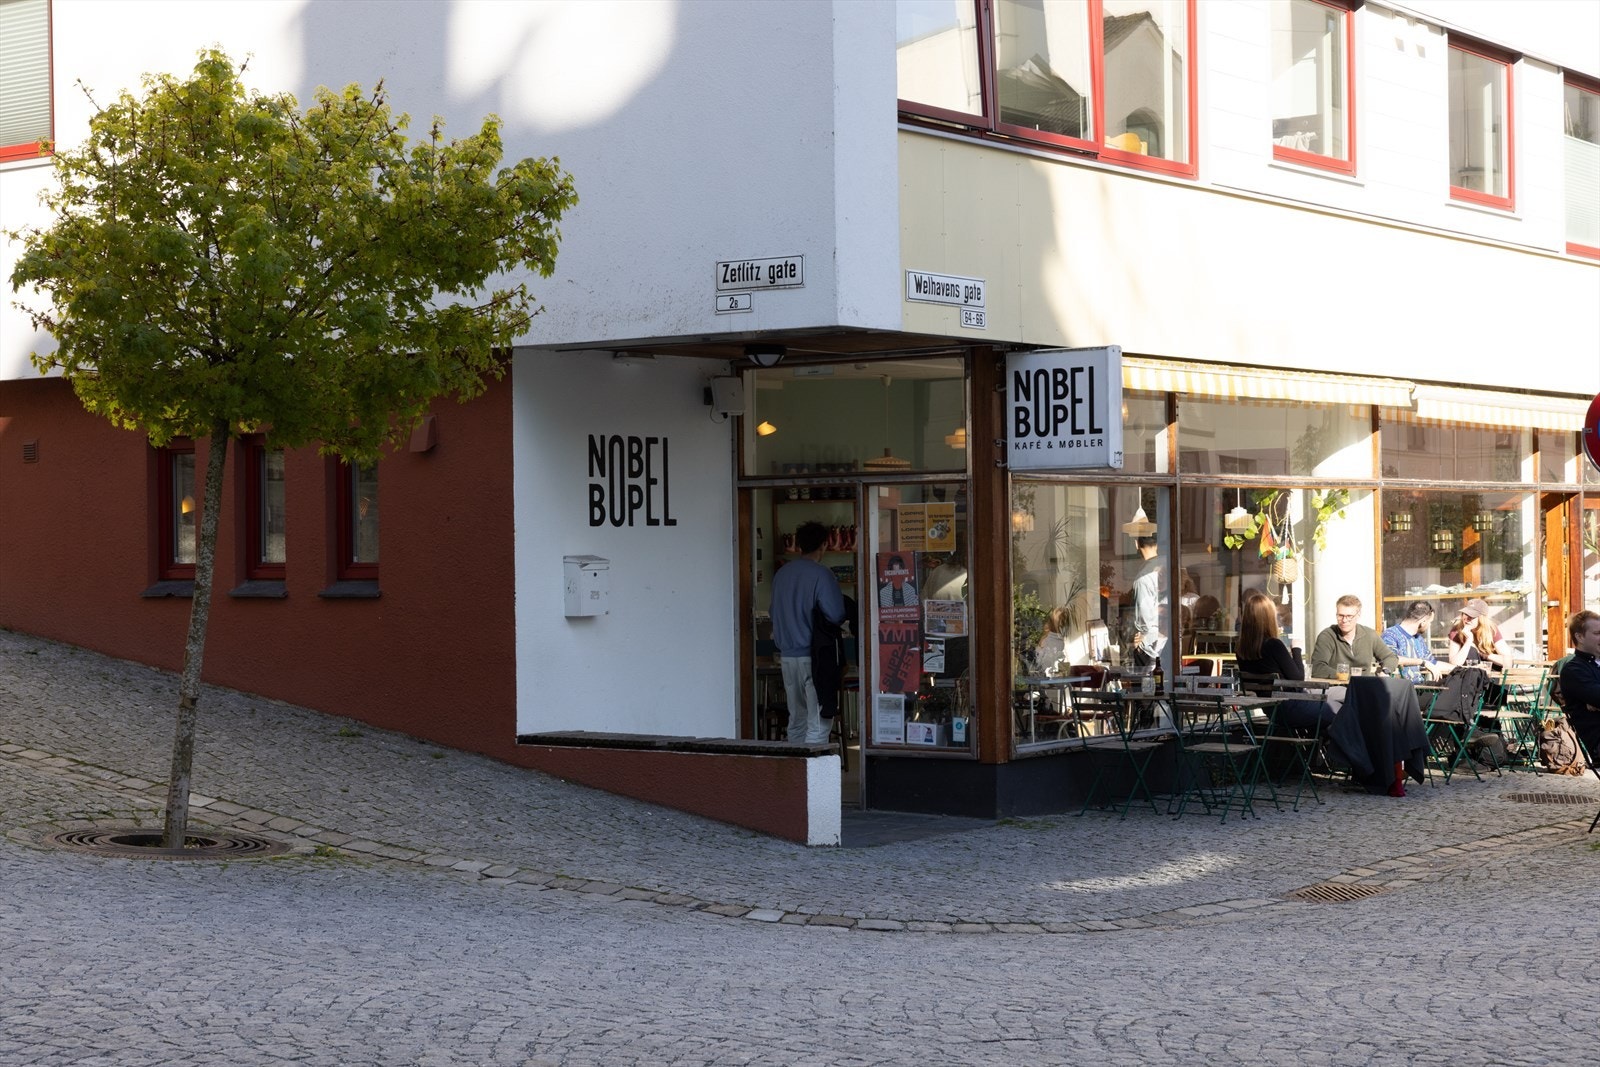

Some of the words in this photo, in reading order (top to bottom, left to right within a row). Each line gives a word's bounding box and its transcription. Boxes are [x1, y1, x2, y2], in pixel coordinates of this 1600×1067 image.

[722, 262, 761, 283] Zetlitz
[768, 260, 796, 284] gate
[914, 274, 960, 298] Welhavens
[964, 283, 982, 303] gate
[729, 296, 739, 309] 2B
[1014, 440, 1042, 450] KAFÉ
[1046, 440, 1054, 449] &
[1059, 438, 1104, 449] MØBLER
[880, 627, 917, 642] YMT
